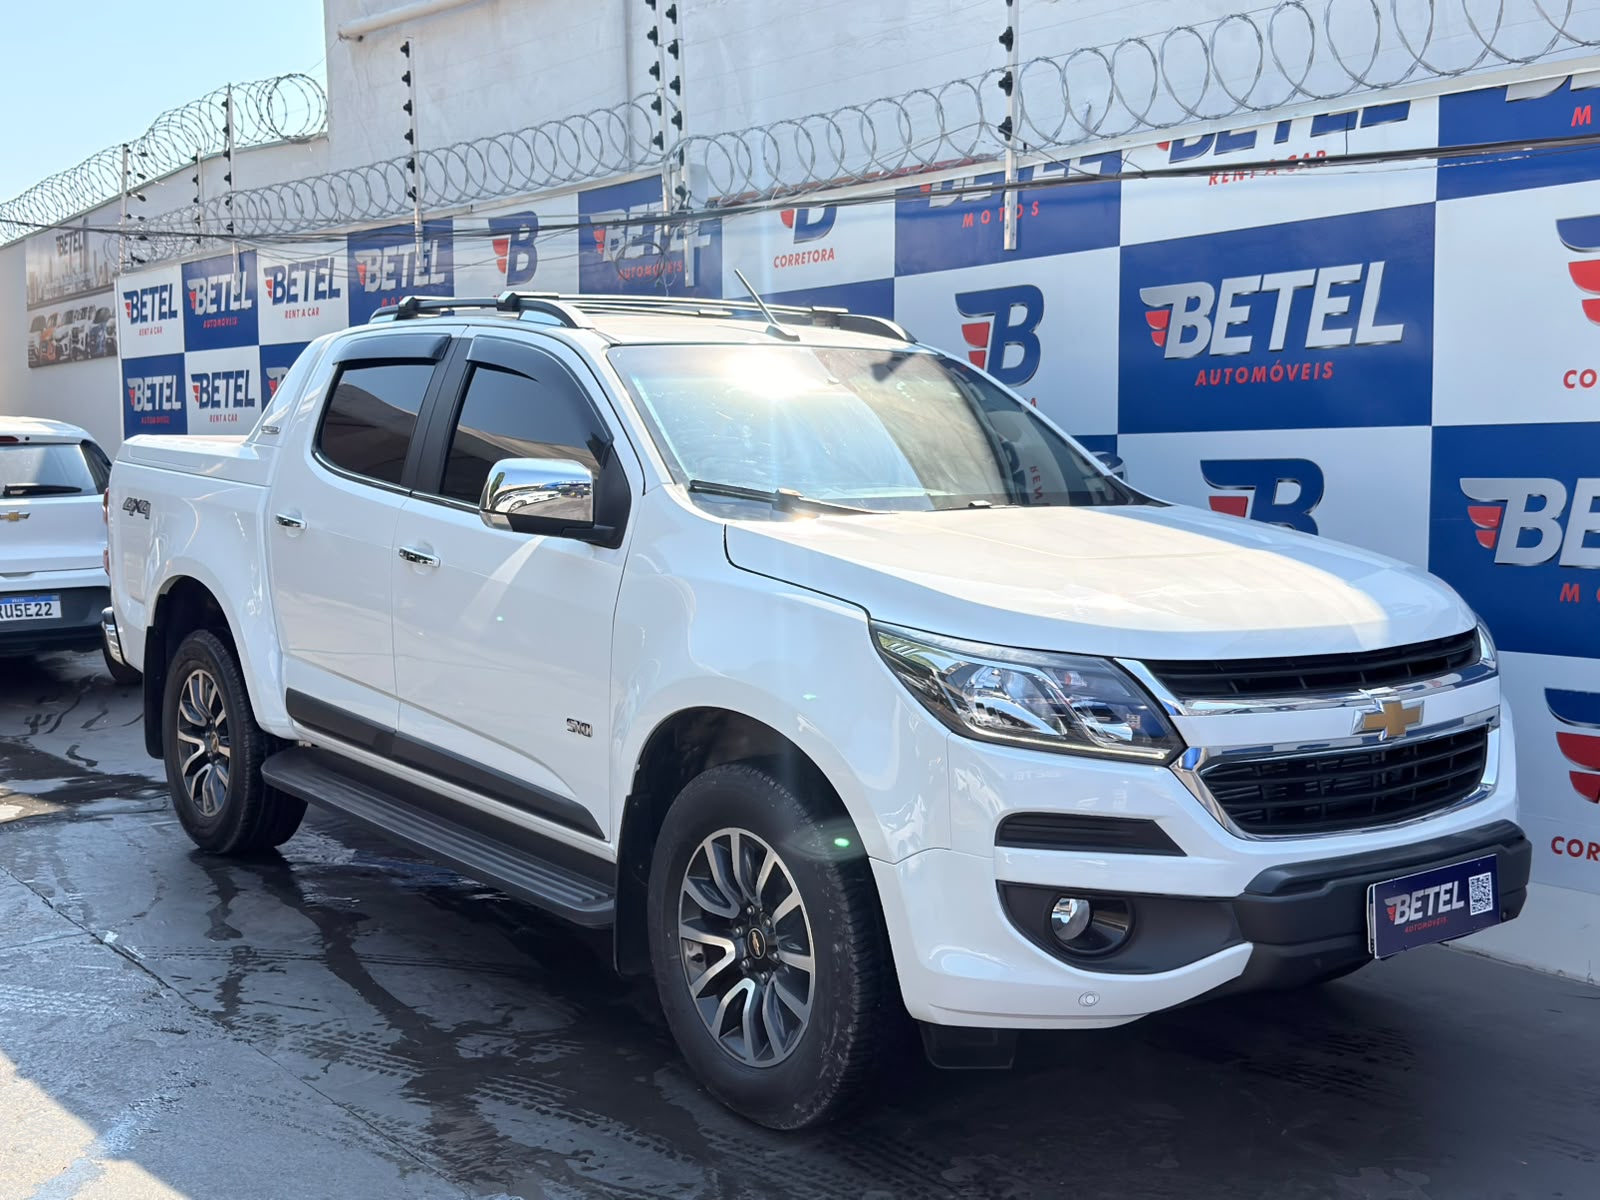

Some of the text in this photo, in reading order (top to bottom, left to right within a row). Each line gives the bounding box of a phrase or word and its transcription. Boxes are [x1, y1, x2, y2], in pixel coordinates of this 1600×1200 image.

[354, 240, 446, 293] BETEL
[773, 247, 835, 269] CORRETORA
[187, 271, 252, 316] BETEL
[263, 257, 341, 306] BETEL
[123, 283, 178, 325] BETEL
[285, 309, 300, 319] RENT
[307, 307, 320, 317] CAR
[1140, 261, 1404, 359] BETEL
[127, 375, 182, 412] BETEL
[191, 369, 255, 410] BETEL
[1195, 360, 1334, 387] AUTOMÓVEIS
[1384, 881, 1465, 925] BETEL
